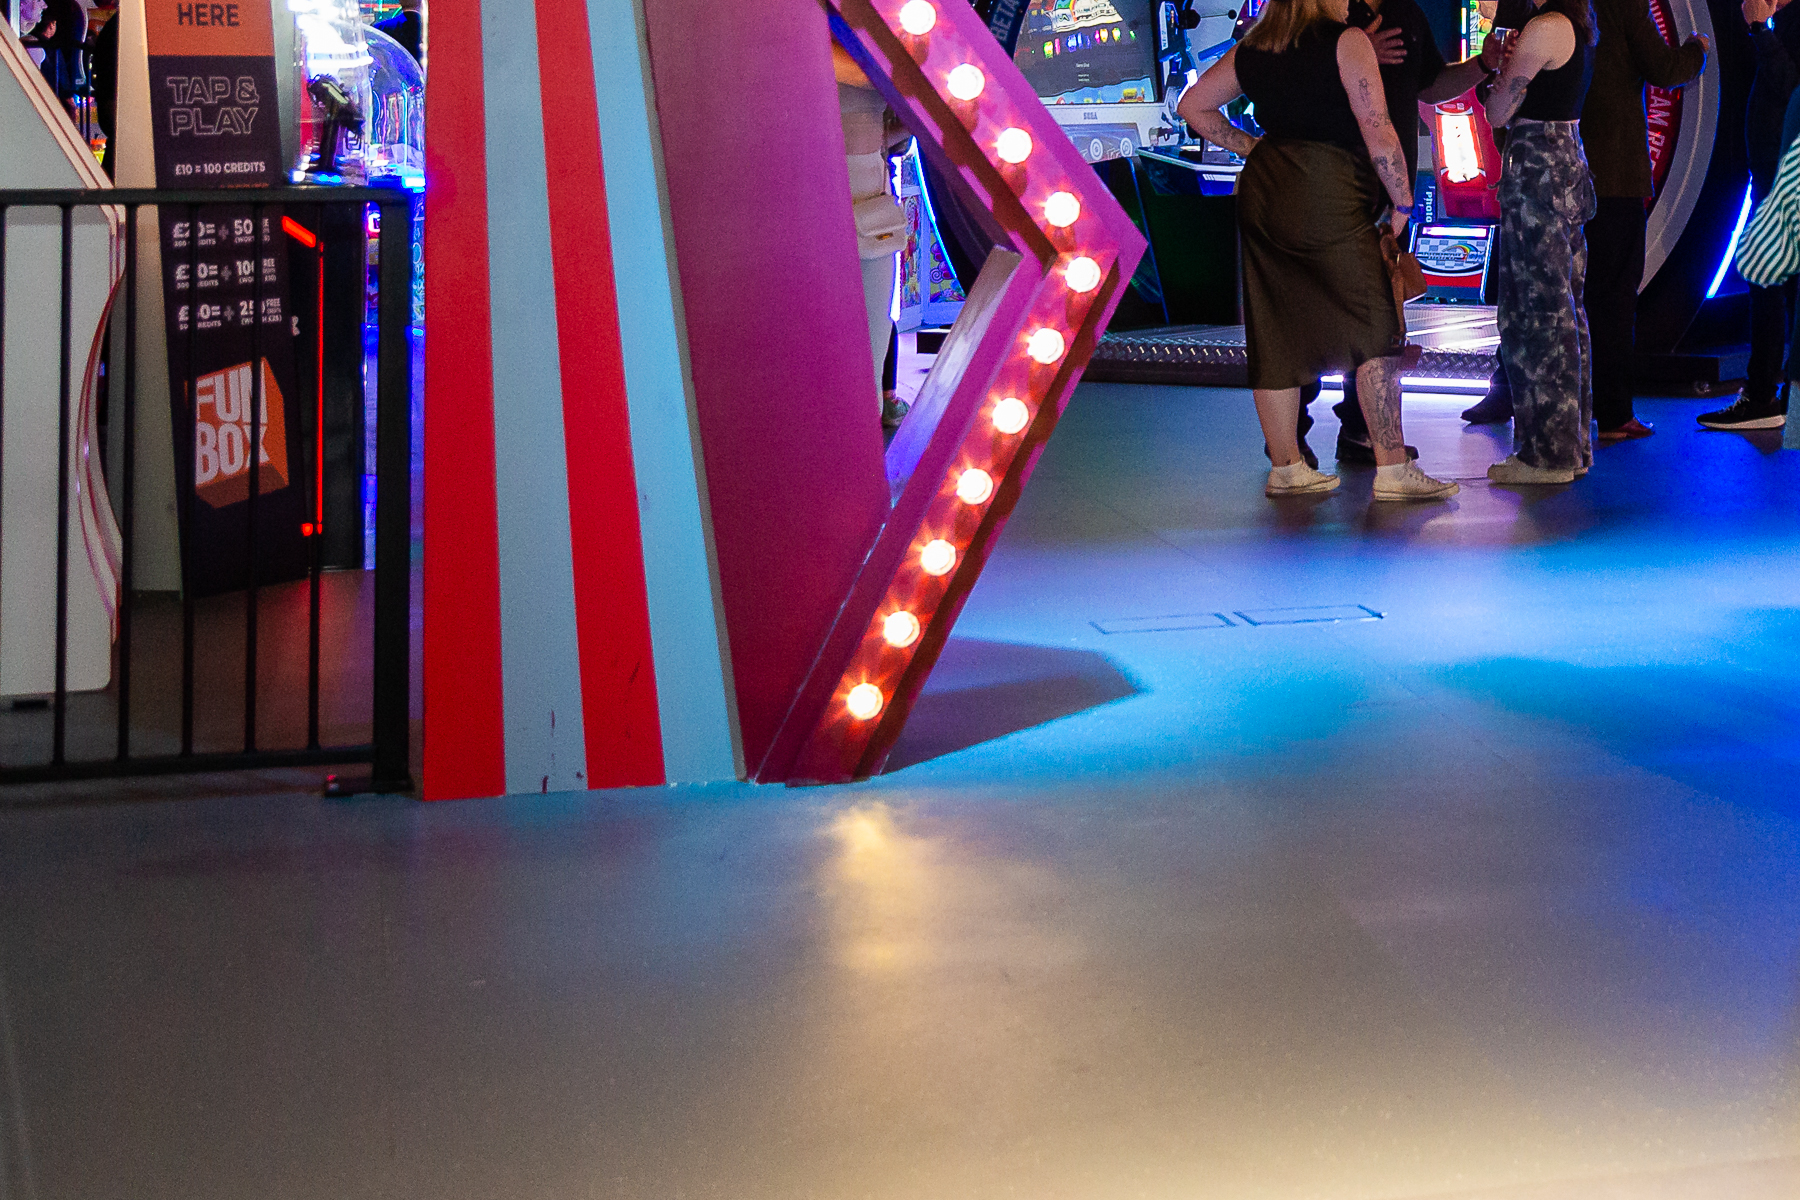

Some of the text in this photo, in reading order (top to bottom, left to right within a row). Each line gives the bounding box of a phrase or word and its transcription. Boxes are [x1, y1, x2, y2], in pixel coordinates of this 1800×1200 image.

[177, 2, 240, 28] HERE
[166, 76, 260, 105] TAP &
[170, 107, 259, 136] PLAY
[175, 163, 193, 176] £10
[203, 162, 221, 174] 100
[223, 161, 266, 173] CREDITS
[196, 364, 268, 425] FUN
[195, 421, 271, 486] BOX
